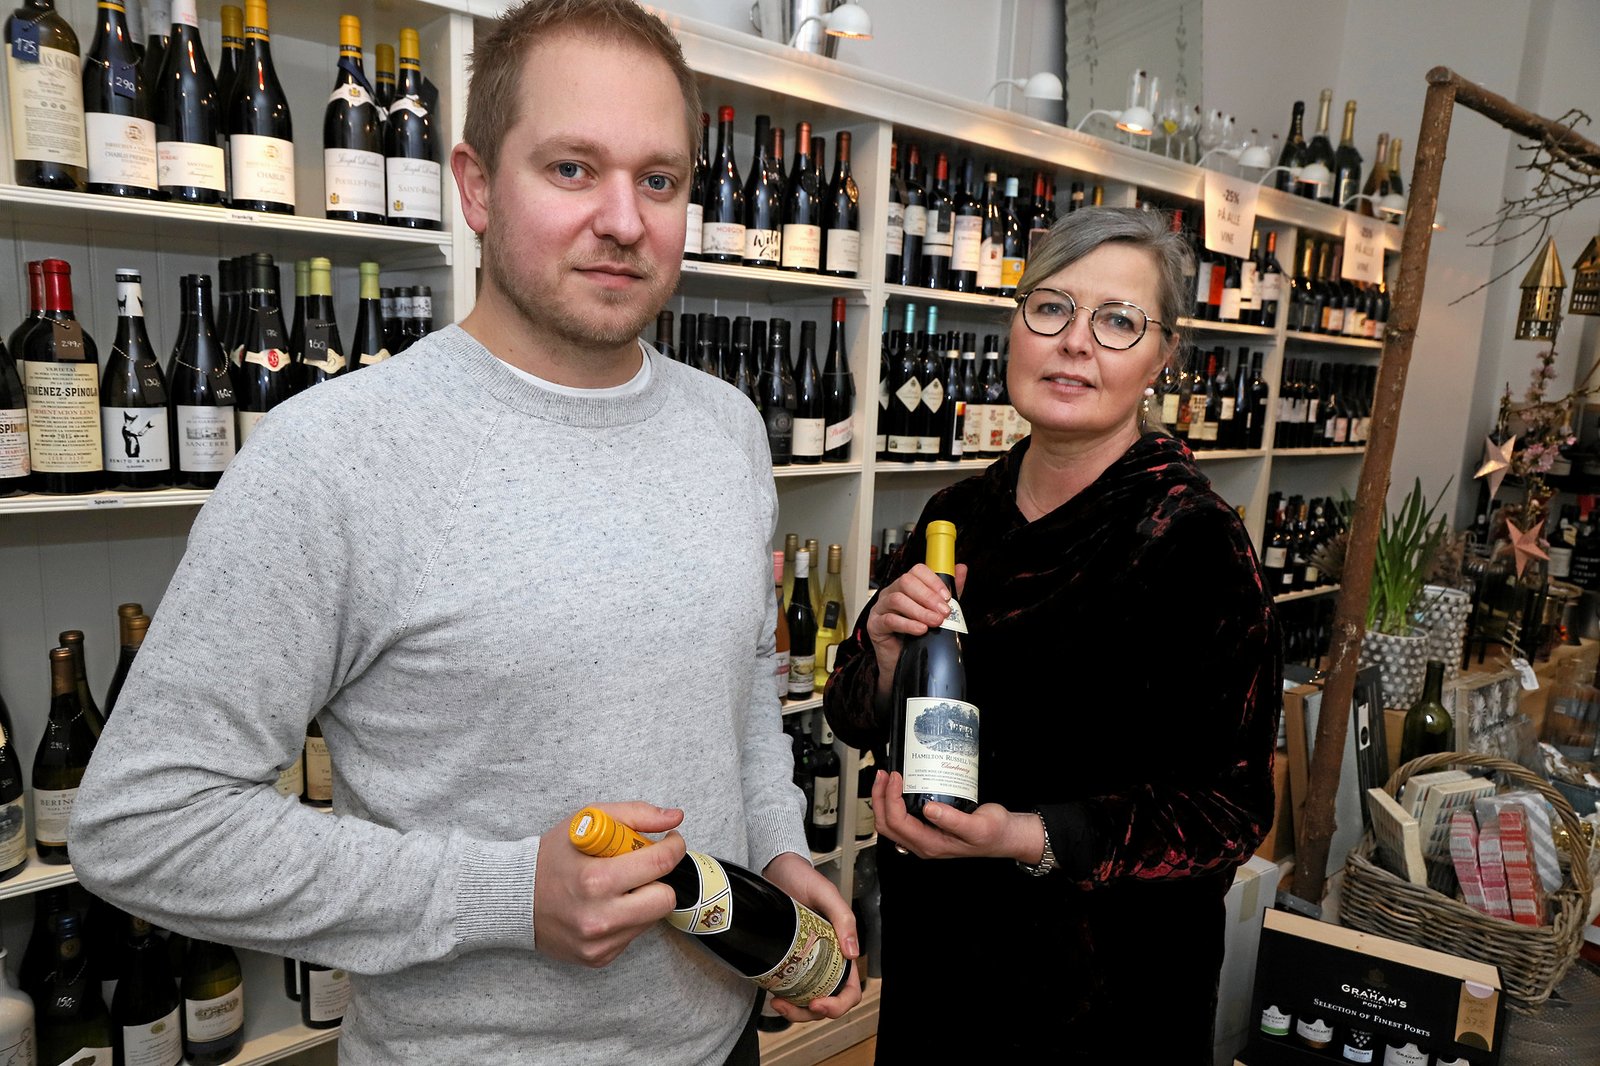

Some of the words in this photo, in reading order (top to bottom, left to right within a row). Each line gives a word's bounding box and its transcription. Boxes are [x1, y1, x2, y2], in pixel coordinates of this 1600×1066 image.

[1222, 188, 1241, 206] -25%
[1226, 212, 1241, 227] ALLE
[1221, 231, 1235, 245] VINE
[911, 752, 944, 760] HAMILTON
[945, 753, 970, 766] RUSSELL
[939, 761, 971, 775] Chardonnay
[1341, 983, 1408, 1009] GRAHAM'S
[1362, 1001, 1383, 1011] PORT
[1313, 998, 1357, 1017] SELECTION
[1359, 1012, 1371, 1021] OF
[1373, 1015, 1403, 1030] FINEST
[1404, 1022, 1431, 1038] PORTS
